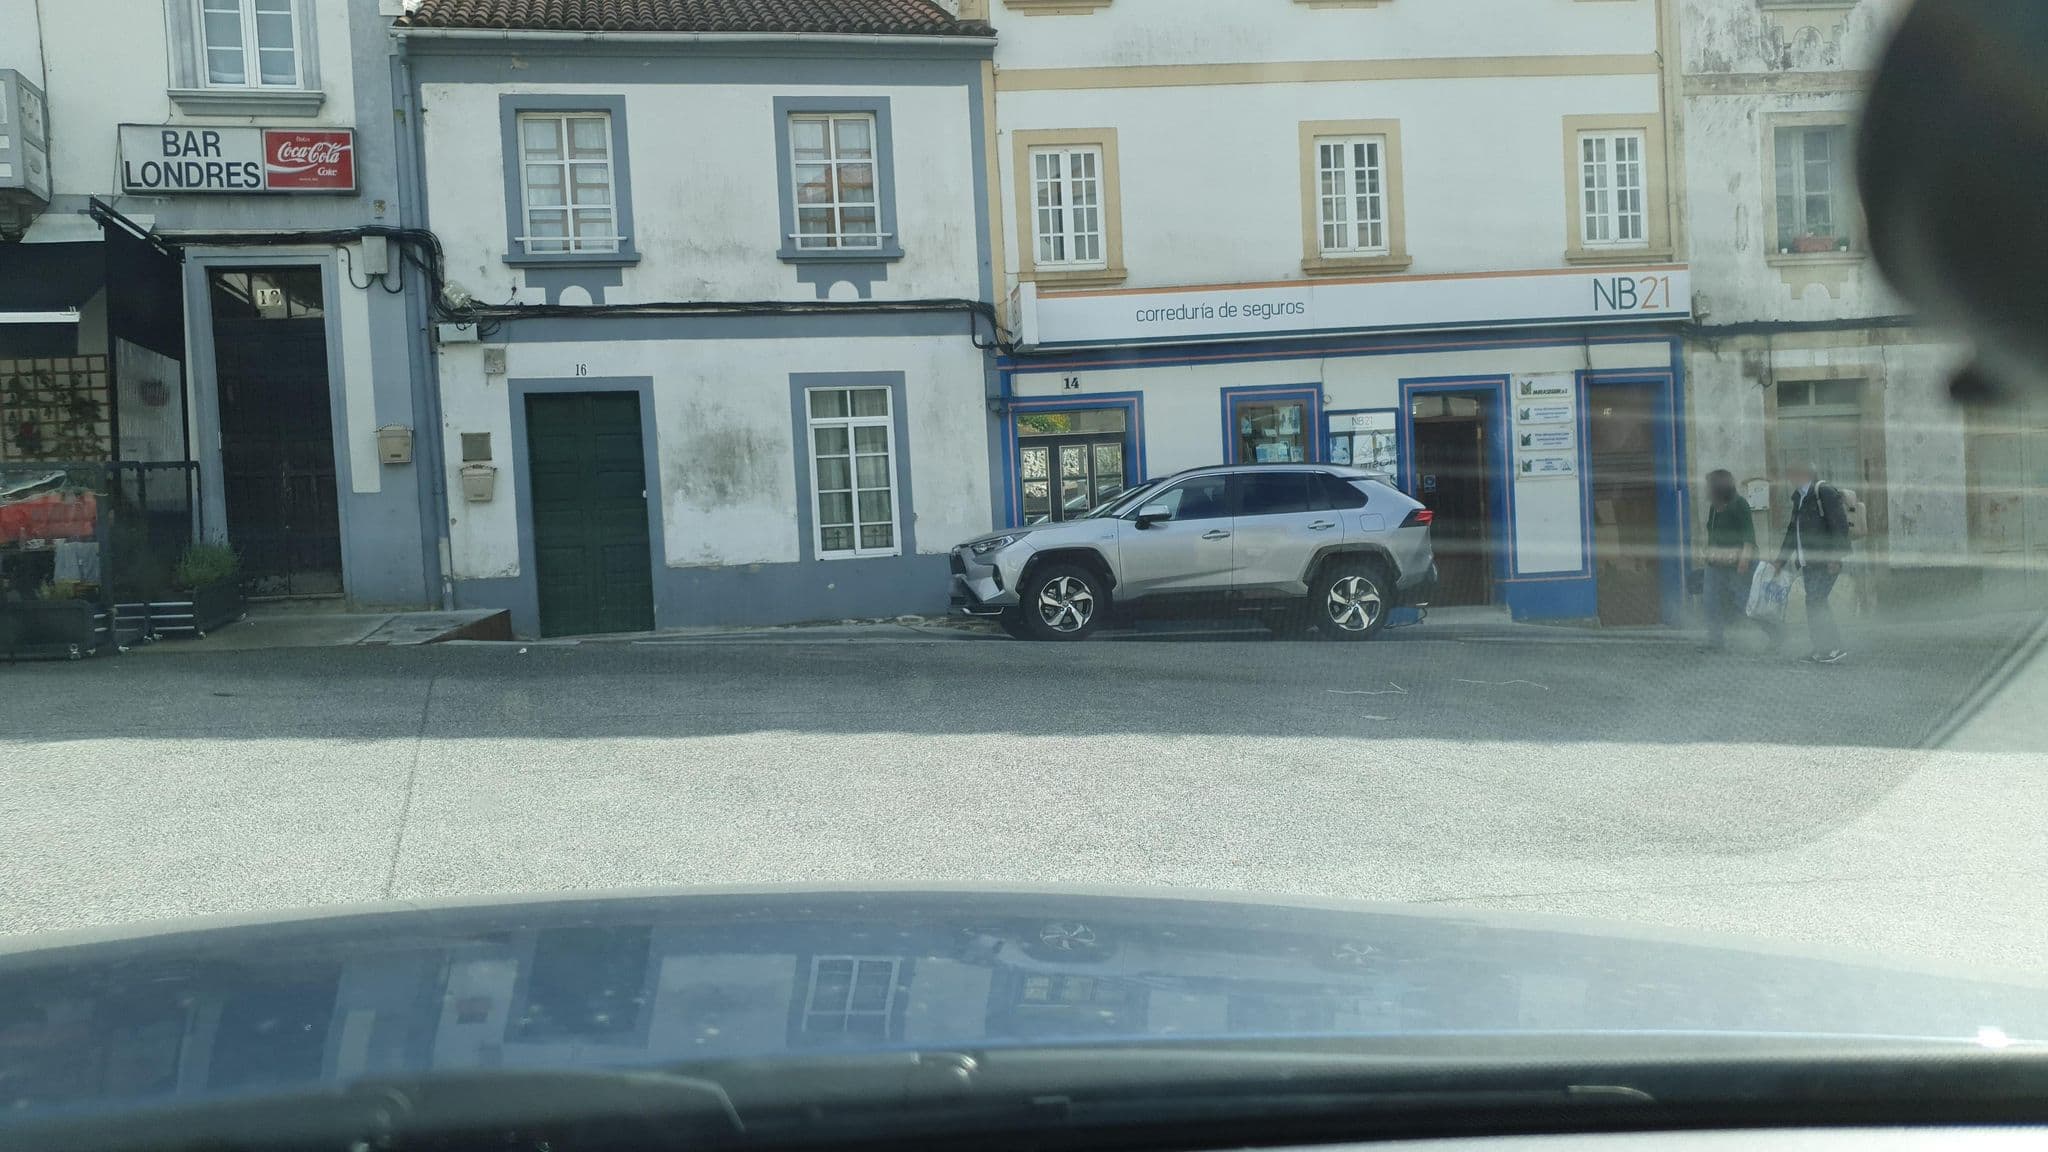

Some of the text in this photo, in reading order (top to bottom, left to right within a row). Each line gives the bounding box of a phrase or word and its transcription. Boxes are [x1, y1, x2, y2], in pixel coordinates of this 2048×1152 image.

[161, 130, 221, 158] BAR
[277, 141, 341, 163] Coca-Cola
[125, 160, 261, 189] LONDRES
[317, 166, 338, 176] Coke
[1593, 276, 1670, 311] NB21
[1136, 301, 1305, 322] correduría de seguros
[575, 363, 587, 376] 16
[1063, 377, 1080, 390] 14
[1351, 415, 1373, 426] NB21
